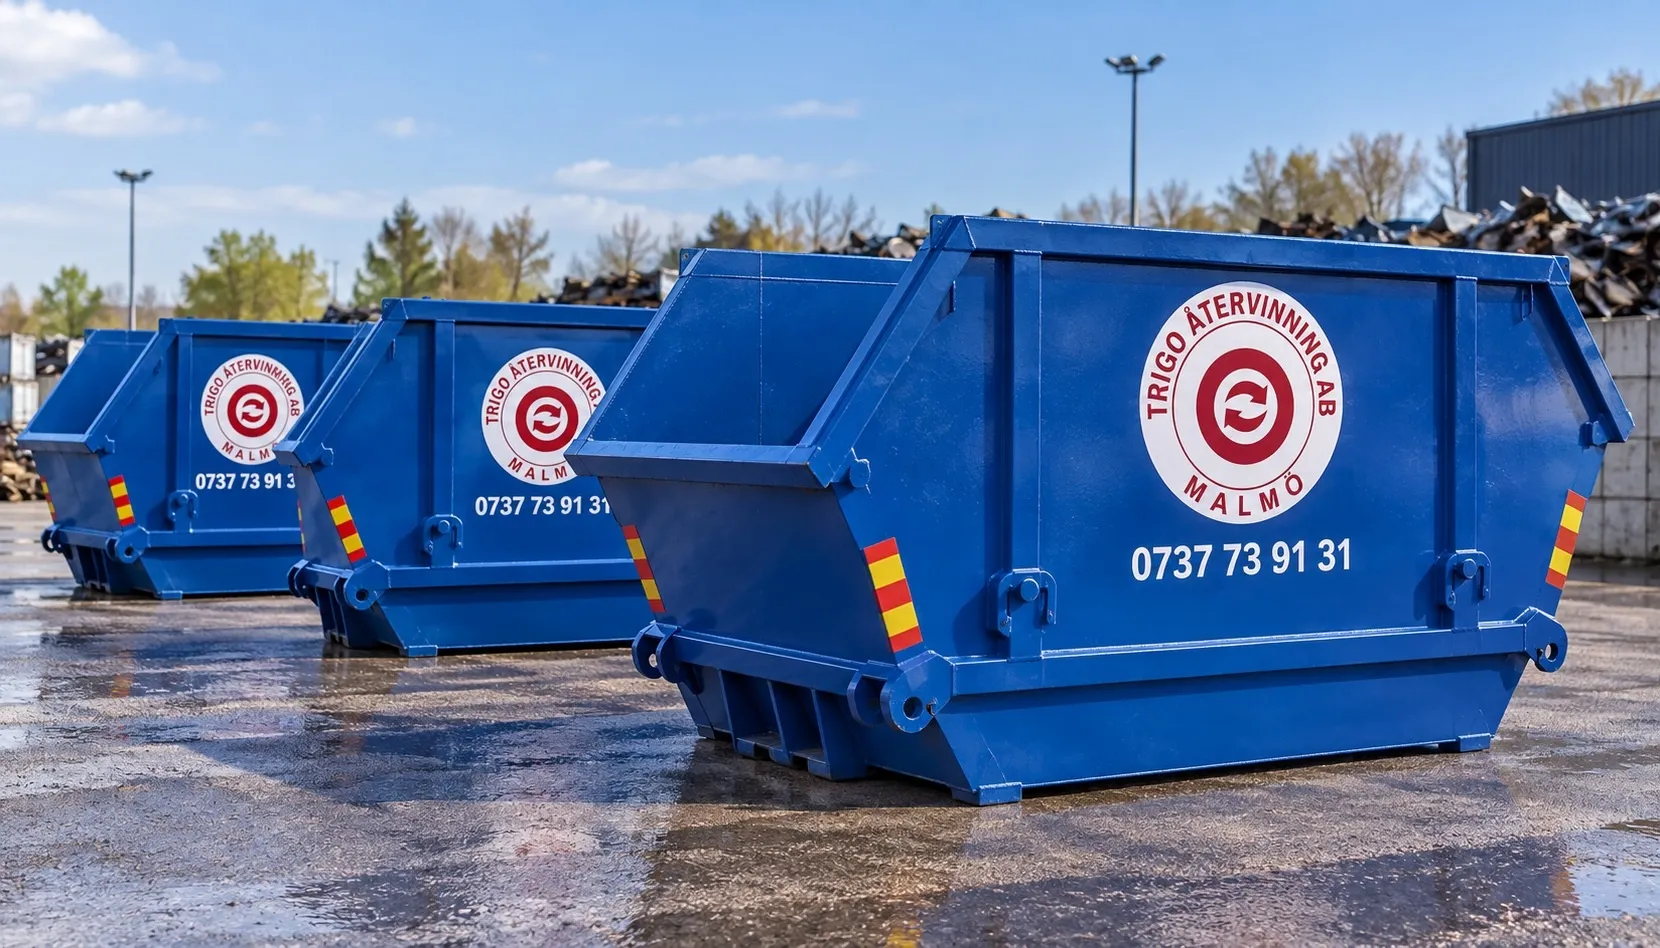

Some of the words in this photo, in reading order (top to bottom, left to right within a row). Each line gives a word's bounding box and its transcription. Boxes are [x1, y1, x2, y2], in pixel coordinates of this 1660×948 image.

[1147, 331, 1187, 420] TRIGO
[1183, 291, 1329, 375] ÅTERVINNING
[1316, 380, 1337, 417] AB
[204, 377, 224, 416] TRIGO
[486, 377, 511, 426] TRIGO
[508, 353, 601, 401] ÅTERVINNING
[221, 441, 279, 461] MALM
[507, 457, 569, 481] MALM
[195, 473, 236, 490] 0737
[240, 473, 260, 490] 73
[264, 473, 282, 489] 91
[286, 473, 296, 489] 3
[1183, 471, 1304, 517] MALMÖ
[474, 496, 525, 516] 0737
[530, 496, 555, 515] 73
[560, 495, 582, 515] 91
[588, 495, 611, 514] 31
[1131, 544, 1213, 582] 0737
[1223, 542, 1262, 577] 73
[1271, 540, 1306, 574] 91
[1317, 537, 1351, 571] 31
